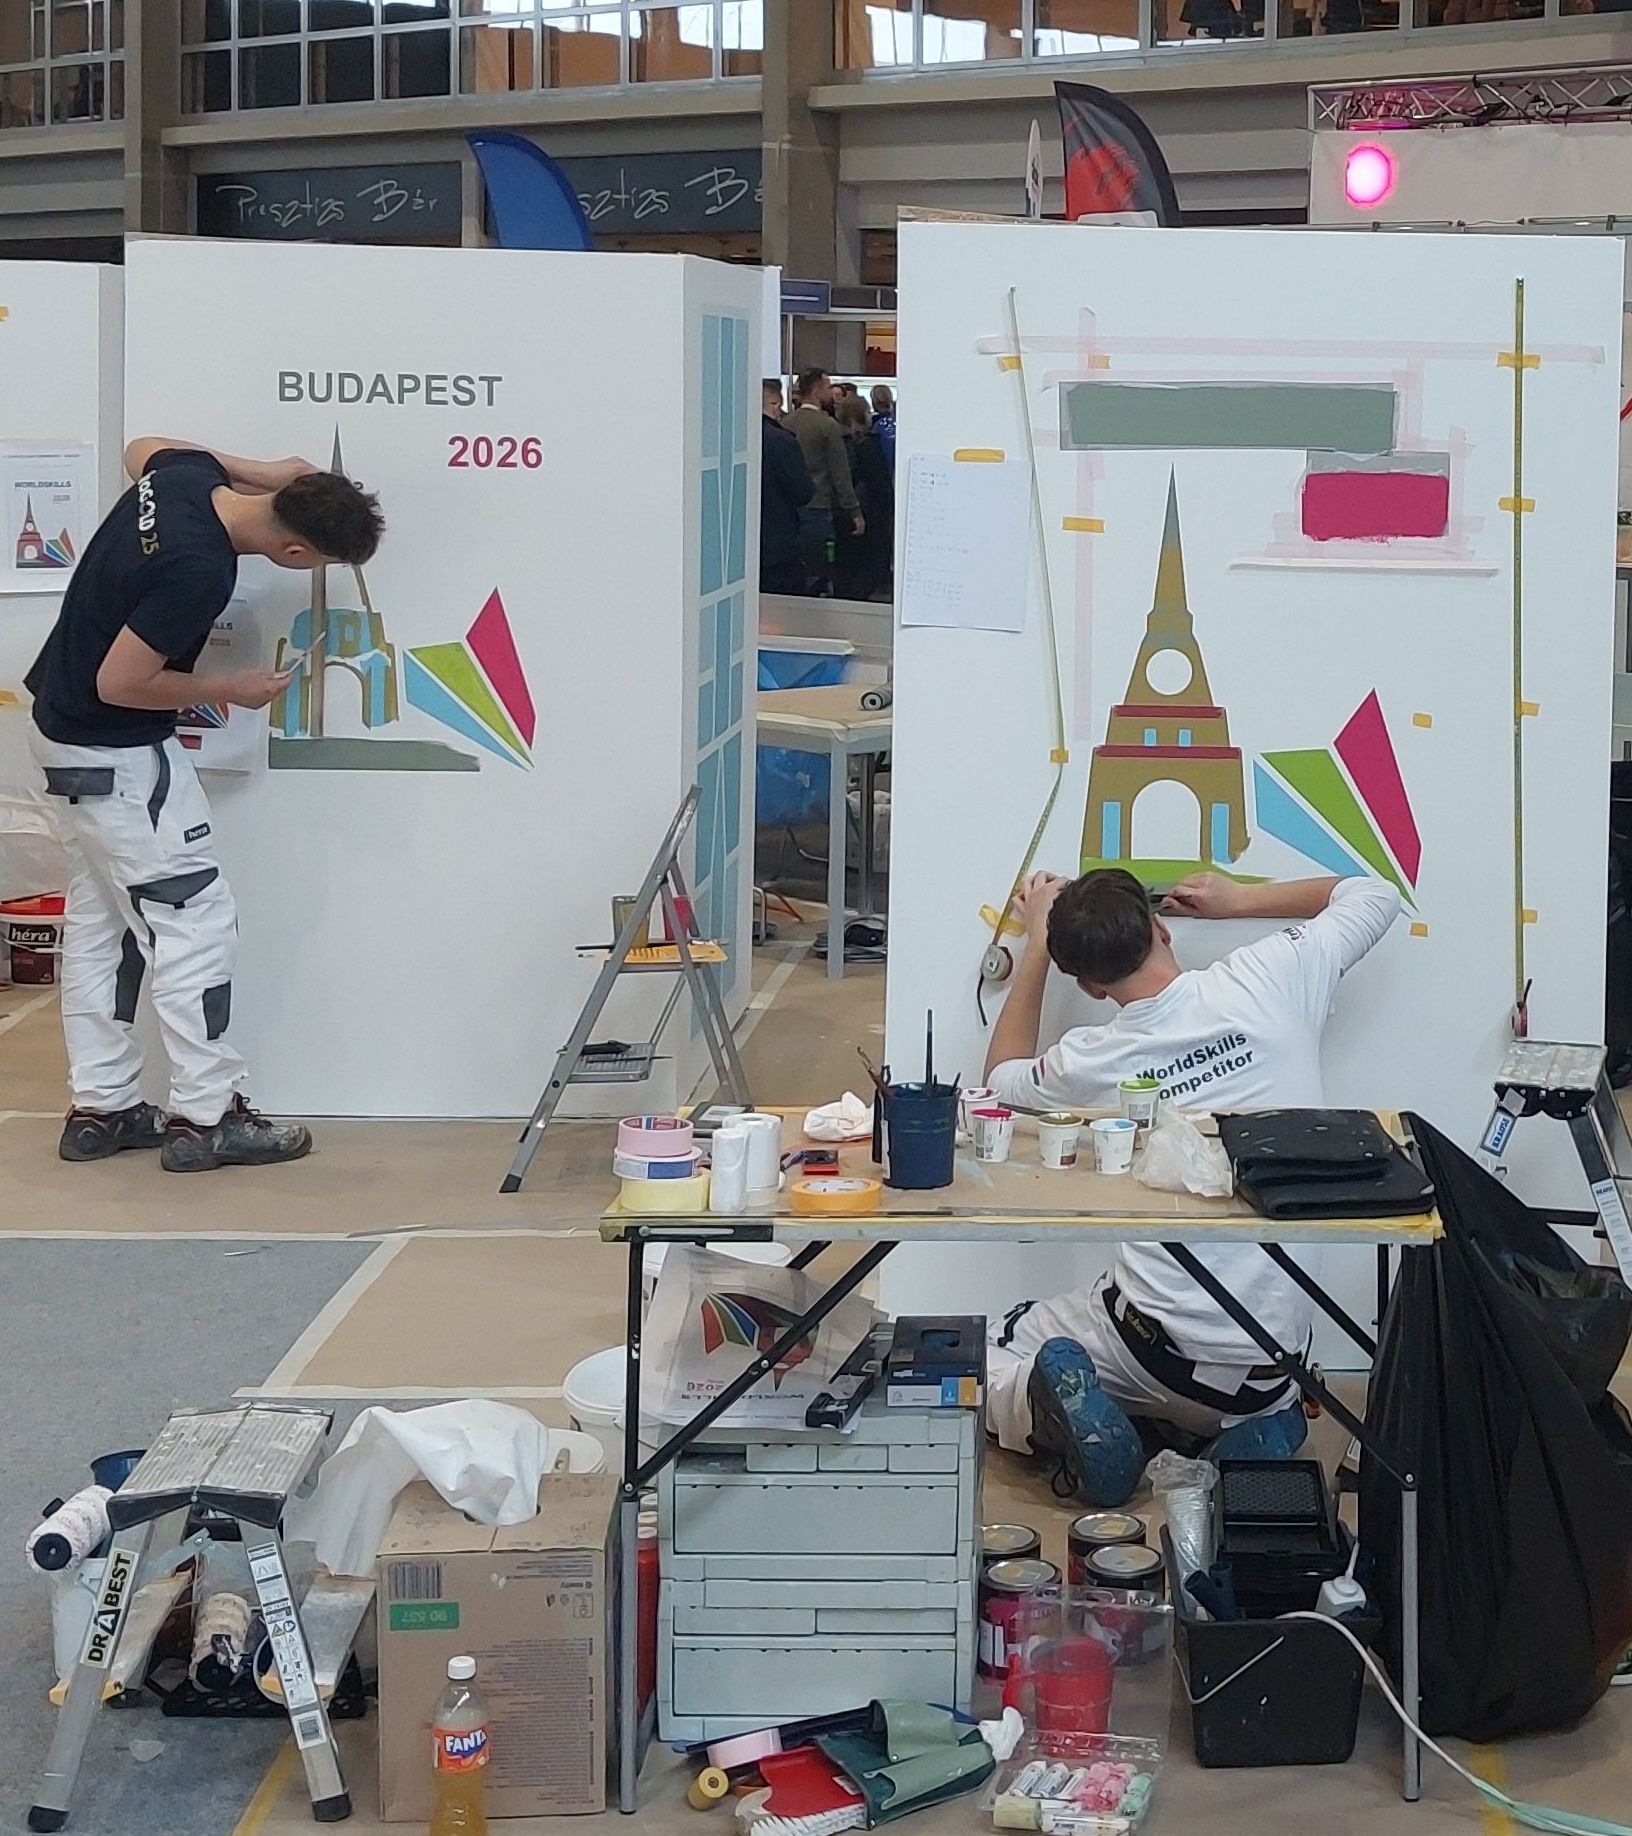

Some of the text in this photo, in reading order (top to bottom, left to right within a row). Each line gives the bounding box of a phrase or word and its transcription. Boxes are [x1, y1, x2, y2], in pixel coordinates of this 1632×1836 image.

[278, 370, 503, 407] BUDAPEST
[447, 435, 543, 469] 2026
[11, 927, 52, 943] héra
[1136, 1031, 1248, 1081] WorldSkills
[1158, 1049, 1255, 1101] ompetitor
[87, 1552, 131, 1662] DRABEST
